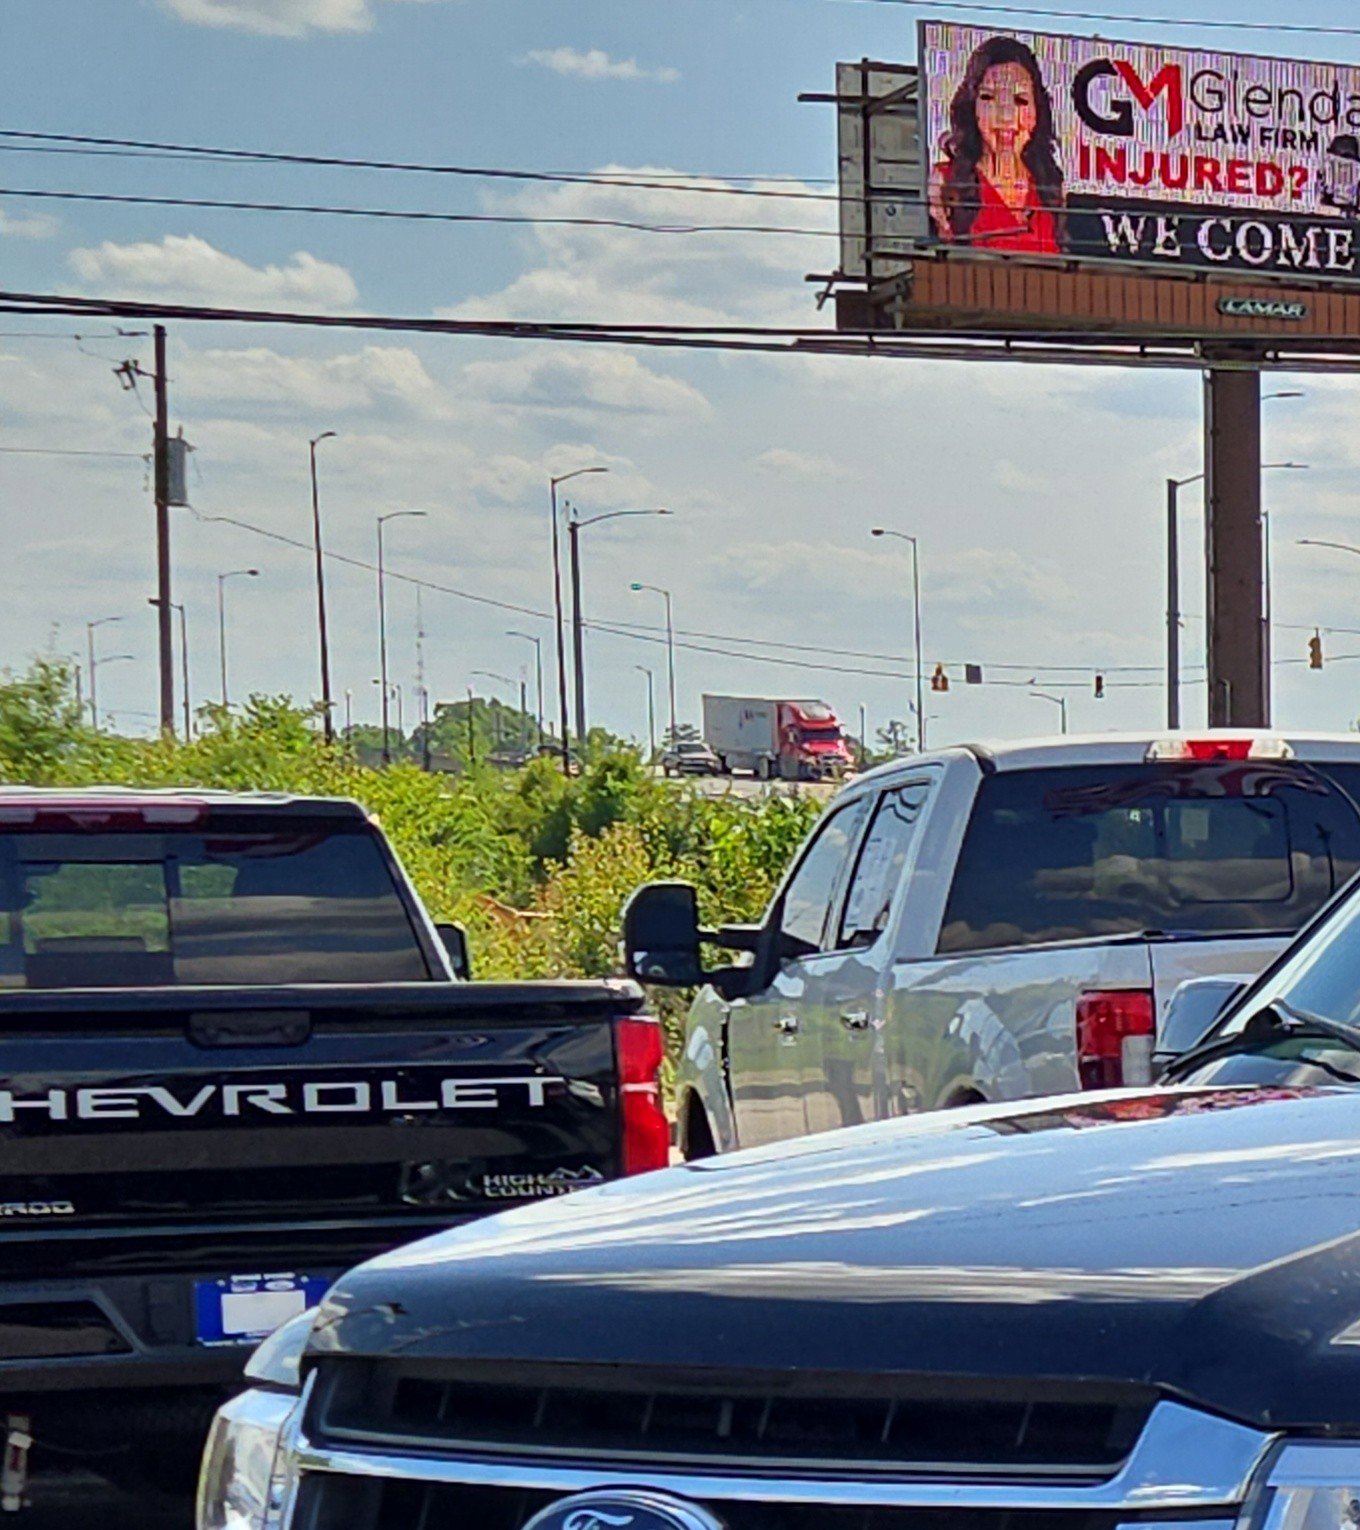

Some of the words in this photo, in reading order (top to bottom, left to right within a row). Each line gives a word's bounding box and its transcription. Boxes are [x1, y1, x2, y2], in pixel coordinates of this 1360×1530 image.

[1195, 122, 1250, 145] LAW
[1259, 126, 1319, 151] FIRM
[1079, 144, 1309, 200] INJURED?
[1101, 213, 1182, 258] WE
[1197, 217, 1355, 272] COME
[1225, 300, 1303, 317] LAMAR
[0, 1077, 565, 1122] HEVROLET
[483, 1174, 547, 1186] HIGH
[484, 1184, 579, 1198] COUNT
